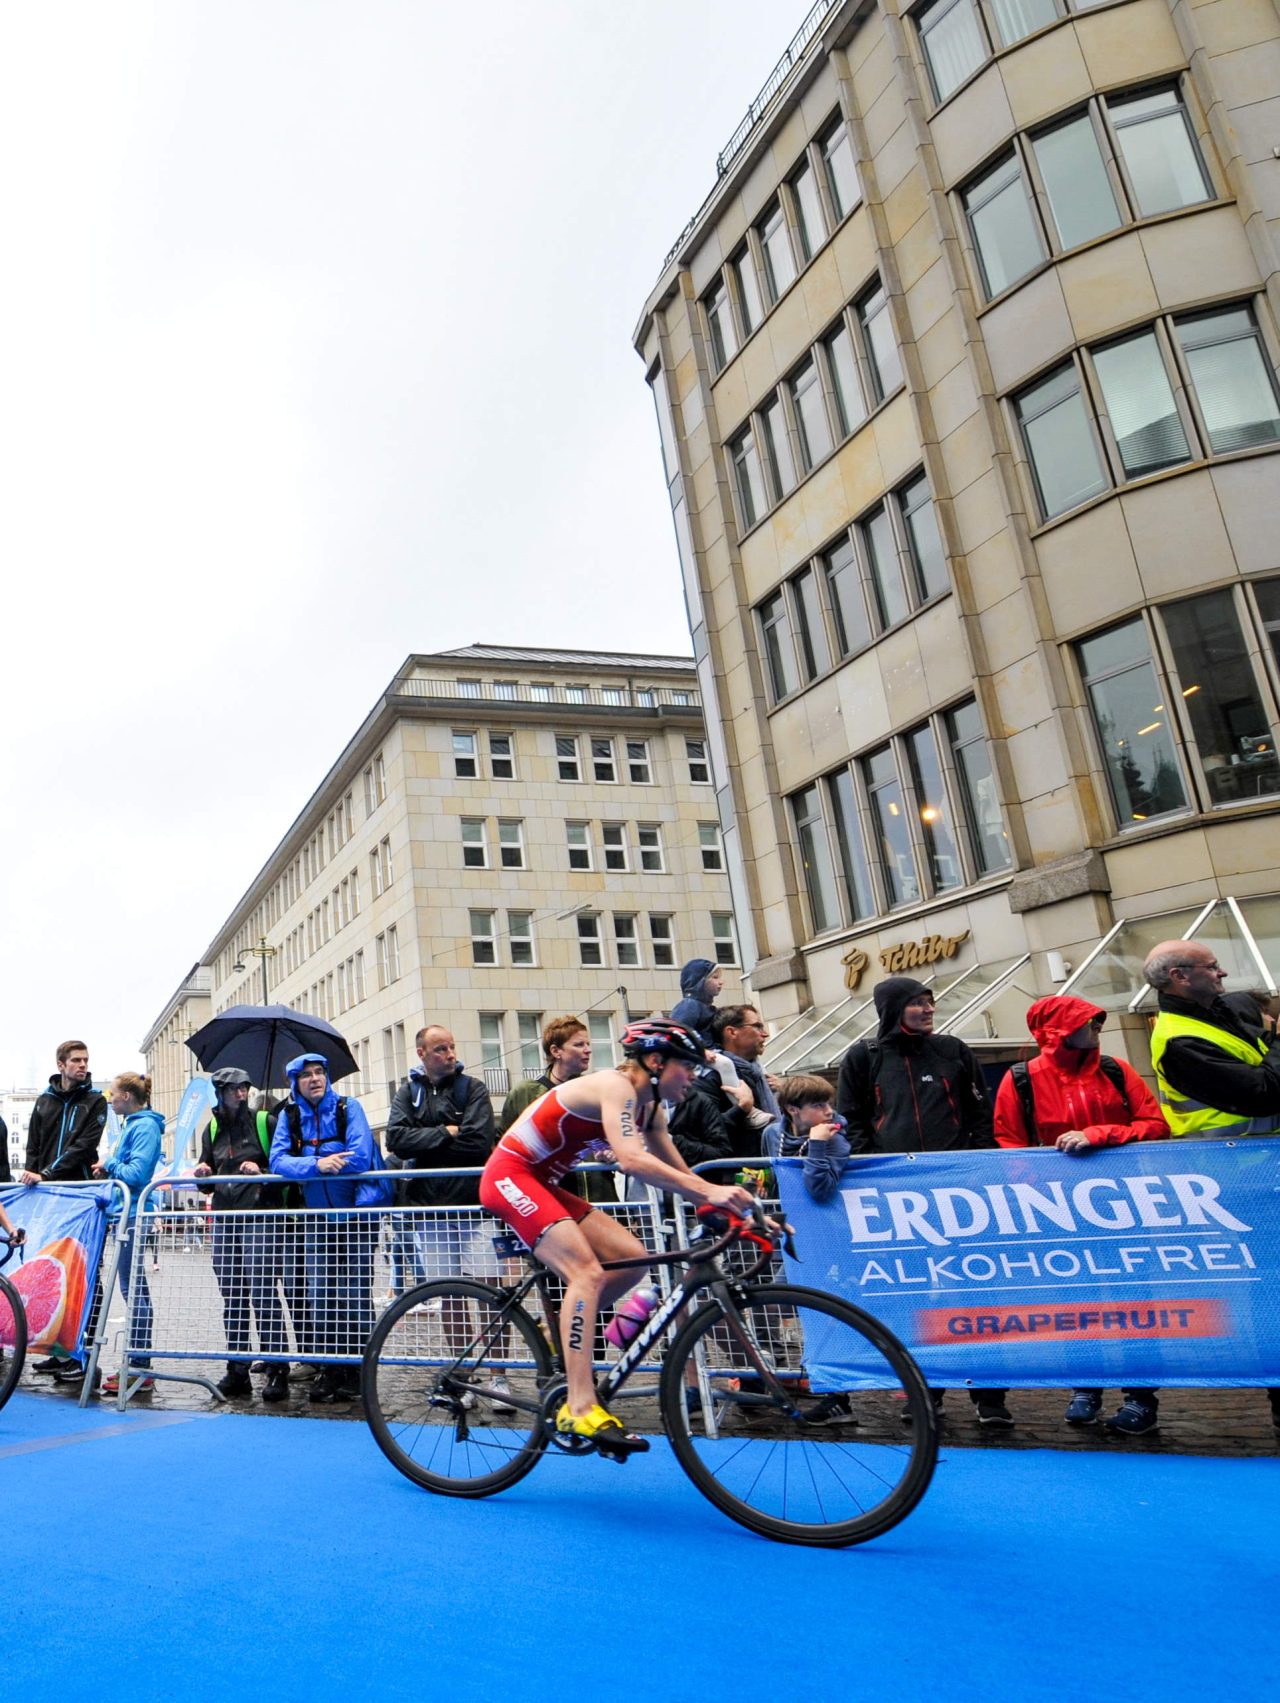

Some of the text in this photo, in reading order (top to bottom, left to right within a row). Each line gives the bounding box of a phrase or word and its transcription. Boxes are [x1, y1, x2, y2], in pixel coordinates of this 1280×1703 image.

[880, 929, 971, 973] Tchibo
[620, 1111, 634, 1137] 22
[837, 1173, 1253, 1248] ERDINGER
[860, 1243, 1257, 1287] ALKOHOLFREI
[569, 1315, 584, 1350] 22
[608, 1283, 685, 1389] STEVENS
[948, 1308, 1196, 1337] GRAPEFRUIT
